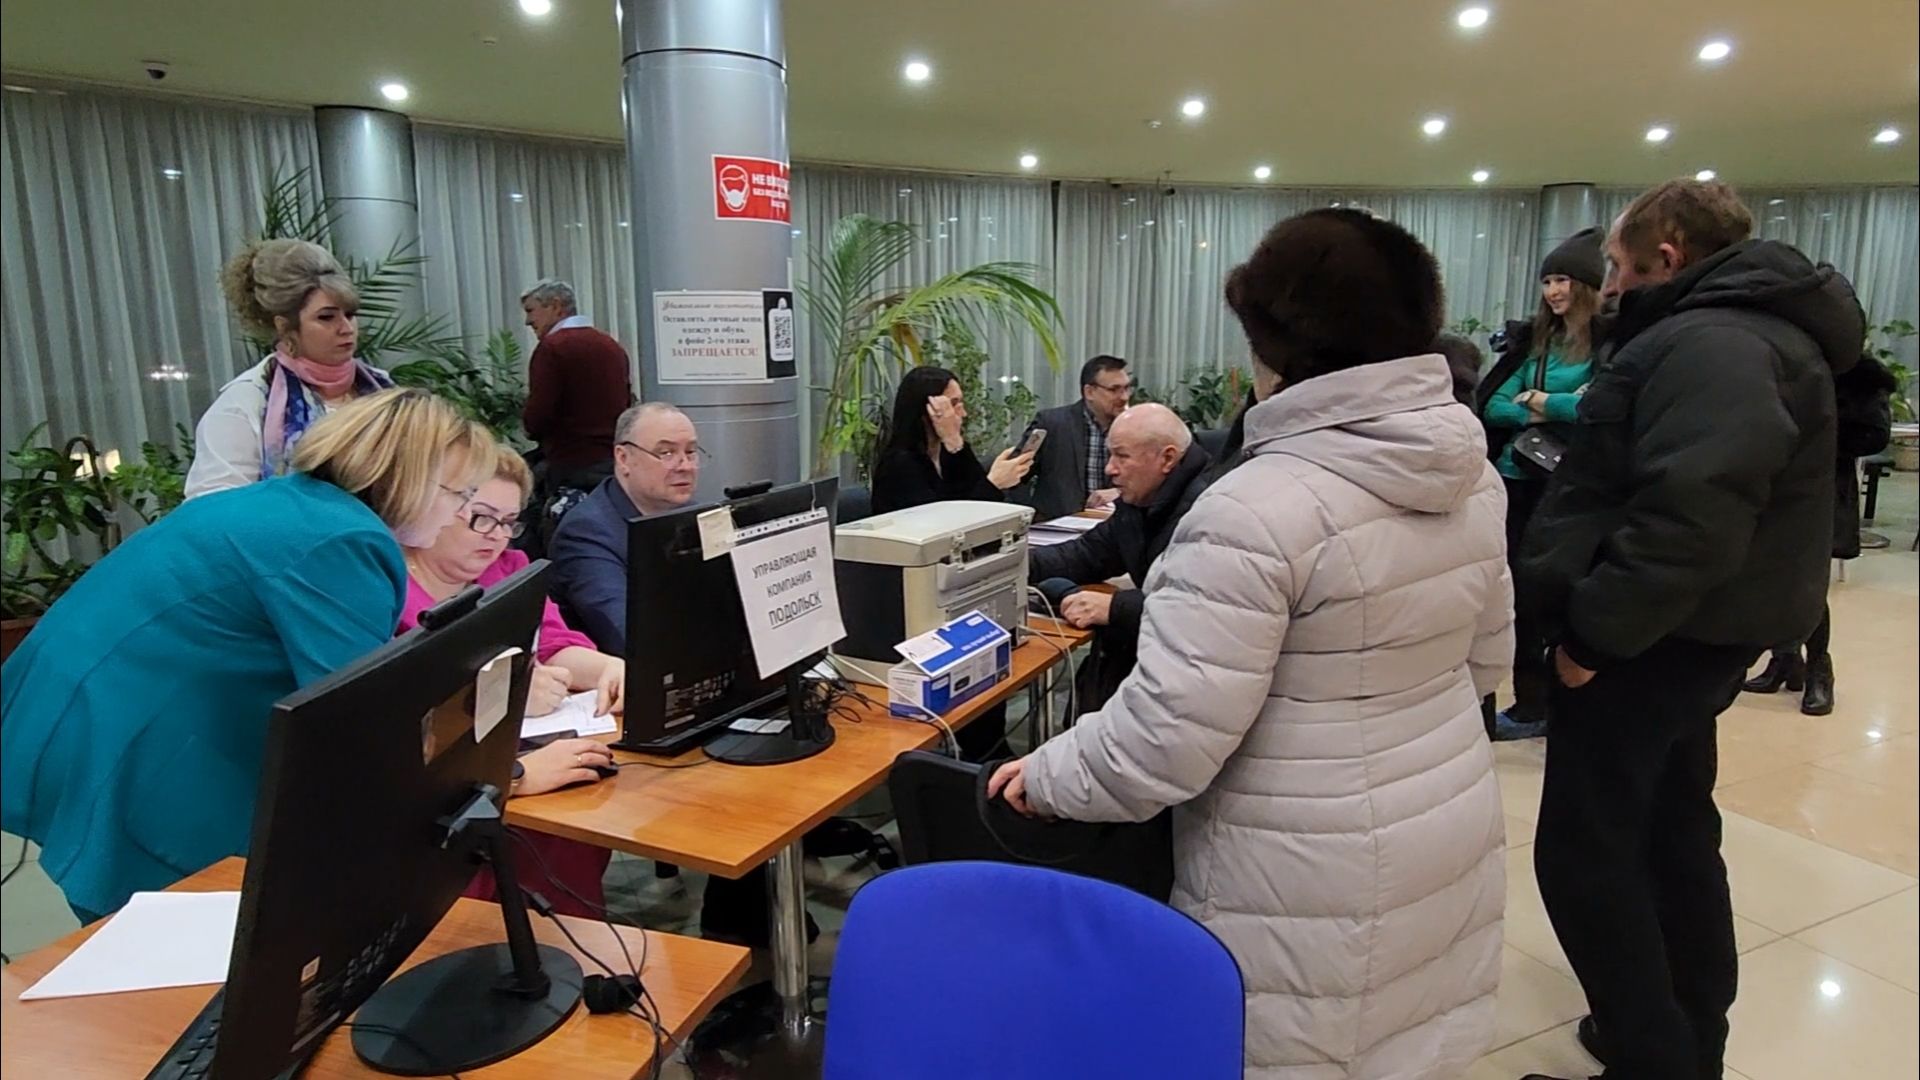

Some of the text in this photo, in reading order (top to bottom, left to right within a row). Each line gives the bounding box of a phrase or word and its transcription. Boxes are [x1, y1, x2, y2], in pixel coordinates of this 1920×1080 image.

[752, 173, 766, 185] НЕ
[672, 348, 758, 357] ЗАПРЕЩАЕТСЯ!
[752, 546, 817, 579] УПРАВЛЯЮЩАЯ
[766, 571, 812, 598] КОМПАНИЯ
[768, 591, 822, 619] ПОДОЛЬСК
